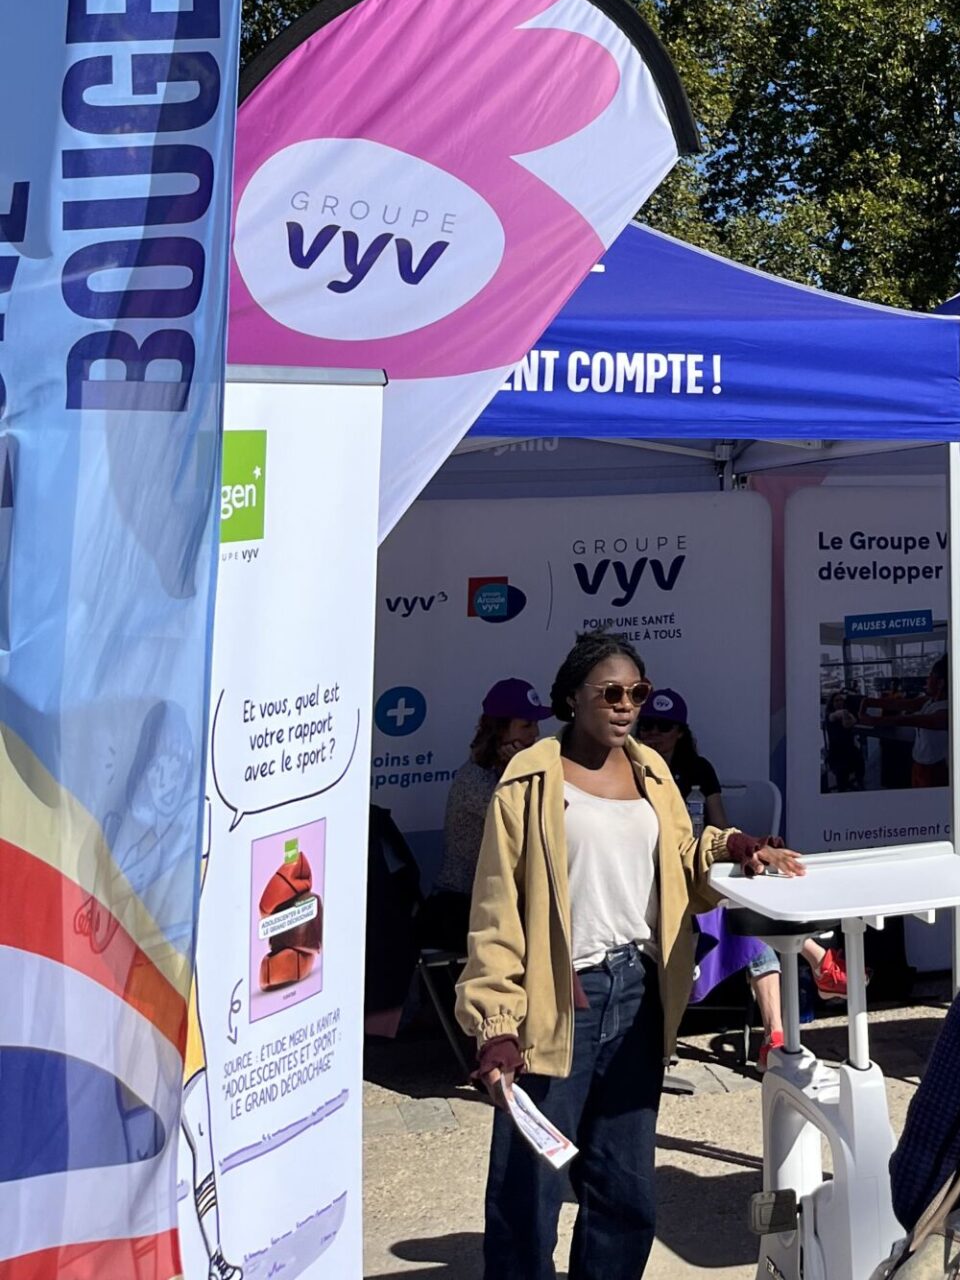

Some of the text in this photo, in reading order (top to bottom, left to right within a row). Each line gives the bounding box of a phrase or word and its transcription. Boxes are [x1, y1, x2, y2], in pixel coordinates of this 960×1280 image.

[291, 191, 457, 233] GROUPE
[286, 221, 450, 293] vyv
[567, 350, 704, 394] COMPTE
[712, 354, 722, 394] !
[221, 483, 256, 519] gen
[572, 536, 687, 554] GROUPE
[819, 531, 843, 550] Le
[850, 531, 931, 554] Groupe
[573, 555, 686, 607] vyv
[818, 561, 943, 584] développer
[616, 617, 638, 628] UNE
[641, 612, 675, 626] SANTÉ
[644, 627, 651, 640] À
[654, 629, 682, 640] TOUS
[852, 617, 927, 631] PAUSES ACTIVES
[243, 682, 340, 723] Et vous, quel est
[250, 712, 333, 751] votre rapport
[245, 737, 336, 782] avec le sport ?
[373, 751, 433, 768] oins et
[824, 829, 841, 842] Un
[845, 823, 940, 841] investissement
[224, 1050, 252, 1079] SOURCE
[289, 1024, 308, 1050] MGEN
[300, 1042, 311, 1065] ET
[313, 1027, 337, 1057] SPORT
[230, 1097, 242, 1120] LE
[245, 1082, 279, 1113] GRAND
